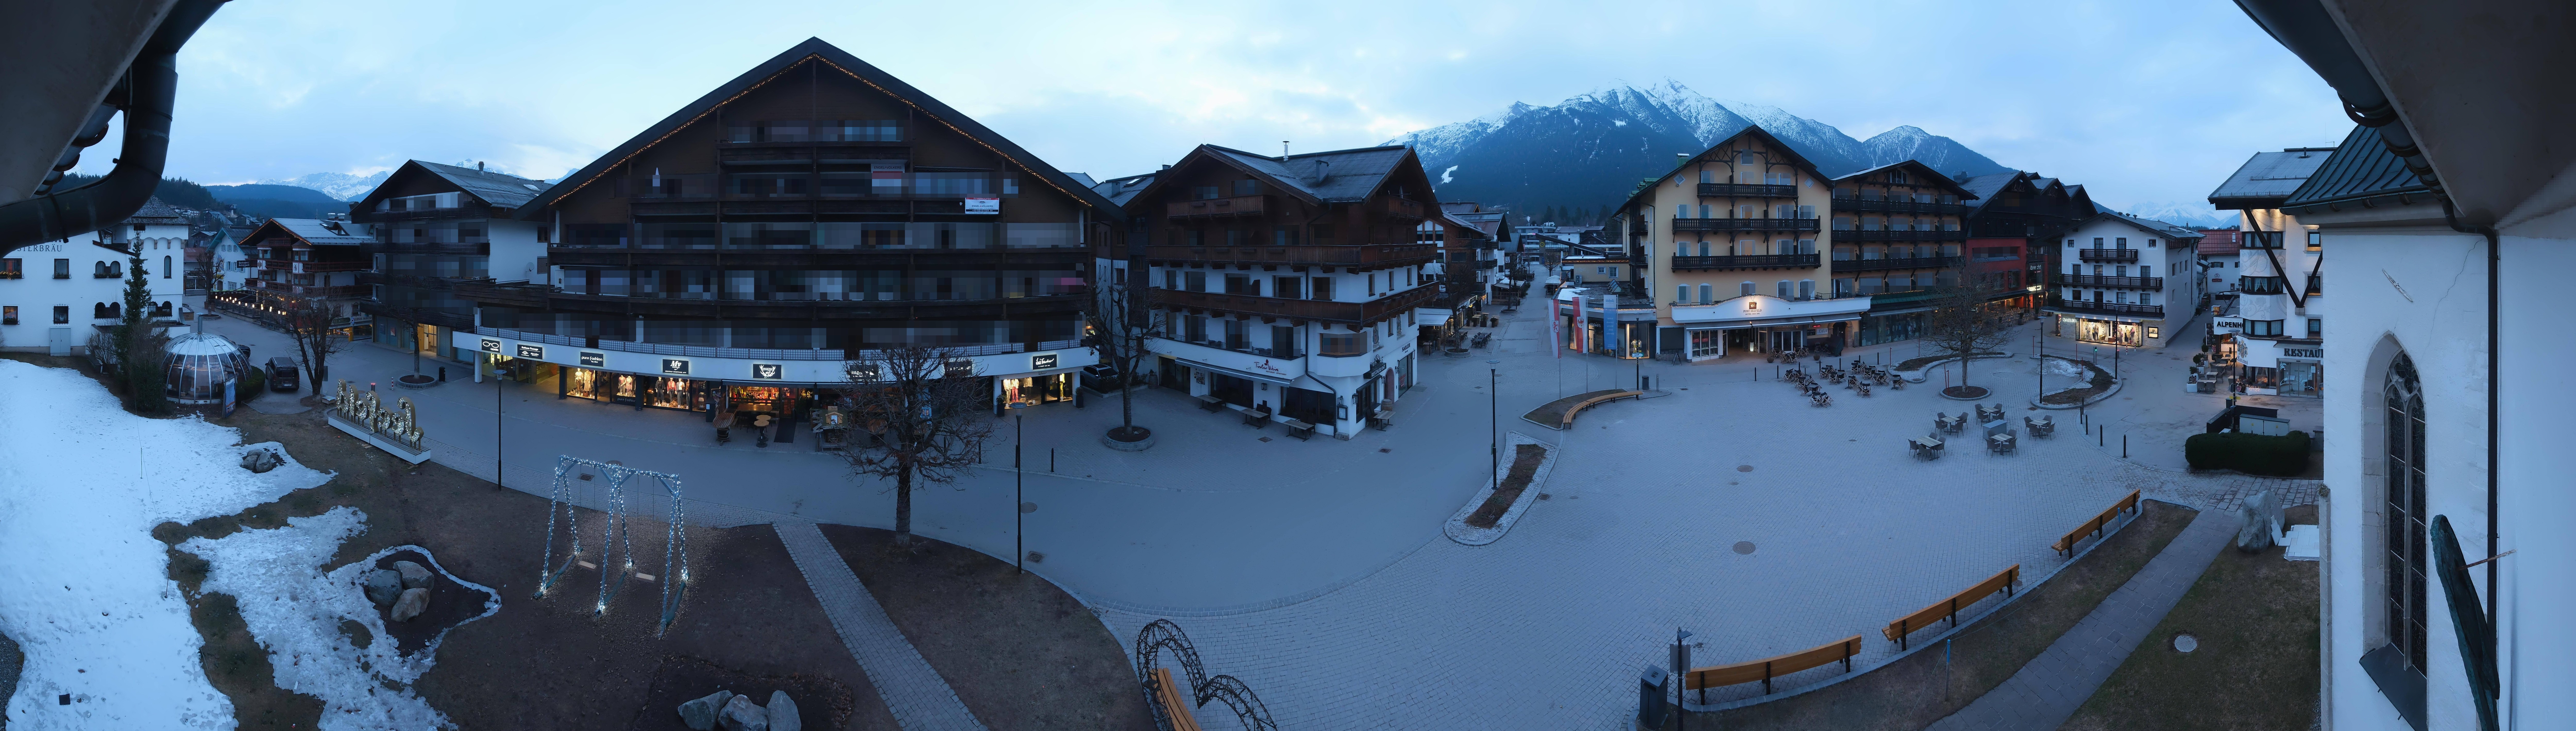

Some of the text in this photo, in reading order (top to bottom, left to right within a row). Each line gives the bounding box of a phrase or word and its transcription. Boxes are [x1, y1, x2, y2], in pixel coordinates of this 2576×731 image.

[1402, 343, 1410, 352] SAILER
[670, 361, 682, 370] My
[1371, 364, 1385, 378] RESTAURANT
